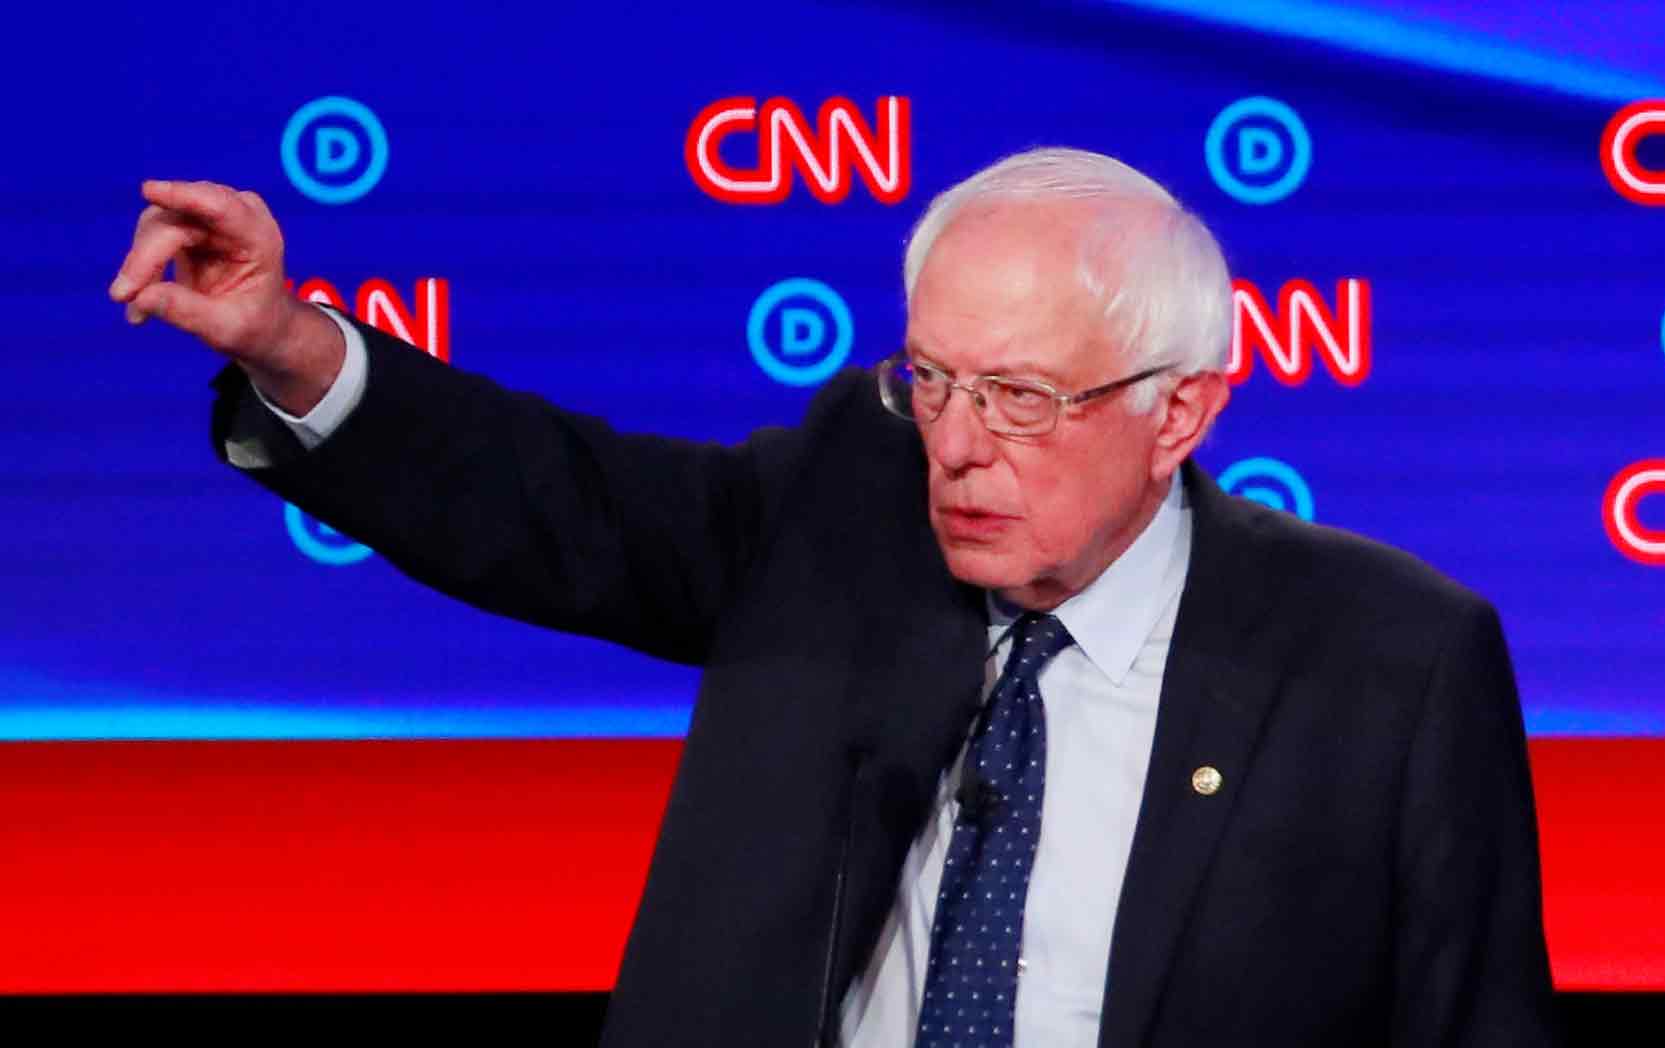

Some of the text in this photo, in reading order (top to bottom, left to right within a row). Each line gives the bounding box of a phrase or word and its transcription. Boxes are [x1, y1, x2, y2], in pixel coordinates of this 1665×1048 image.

[316, 127, 359, 173] D
[686, 97, 910, 203] CNN
[1238, 127, 1283, 174] D
[782, 308, 824, 354] D
[1228, 278, 1371, 386] NN
